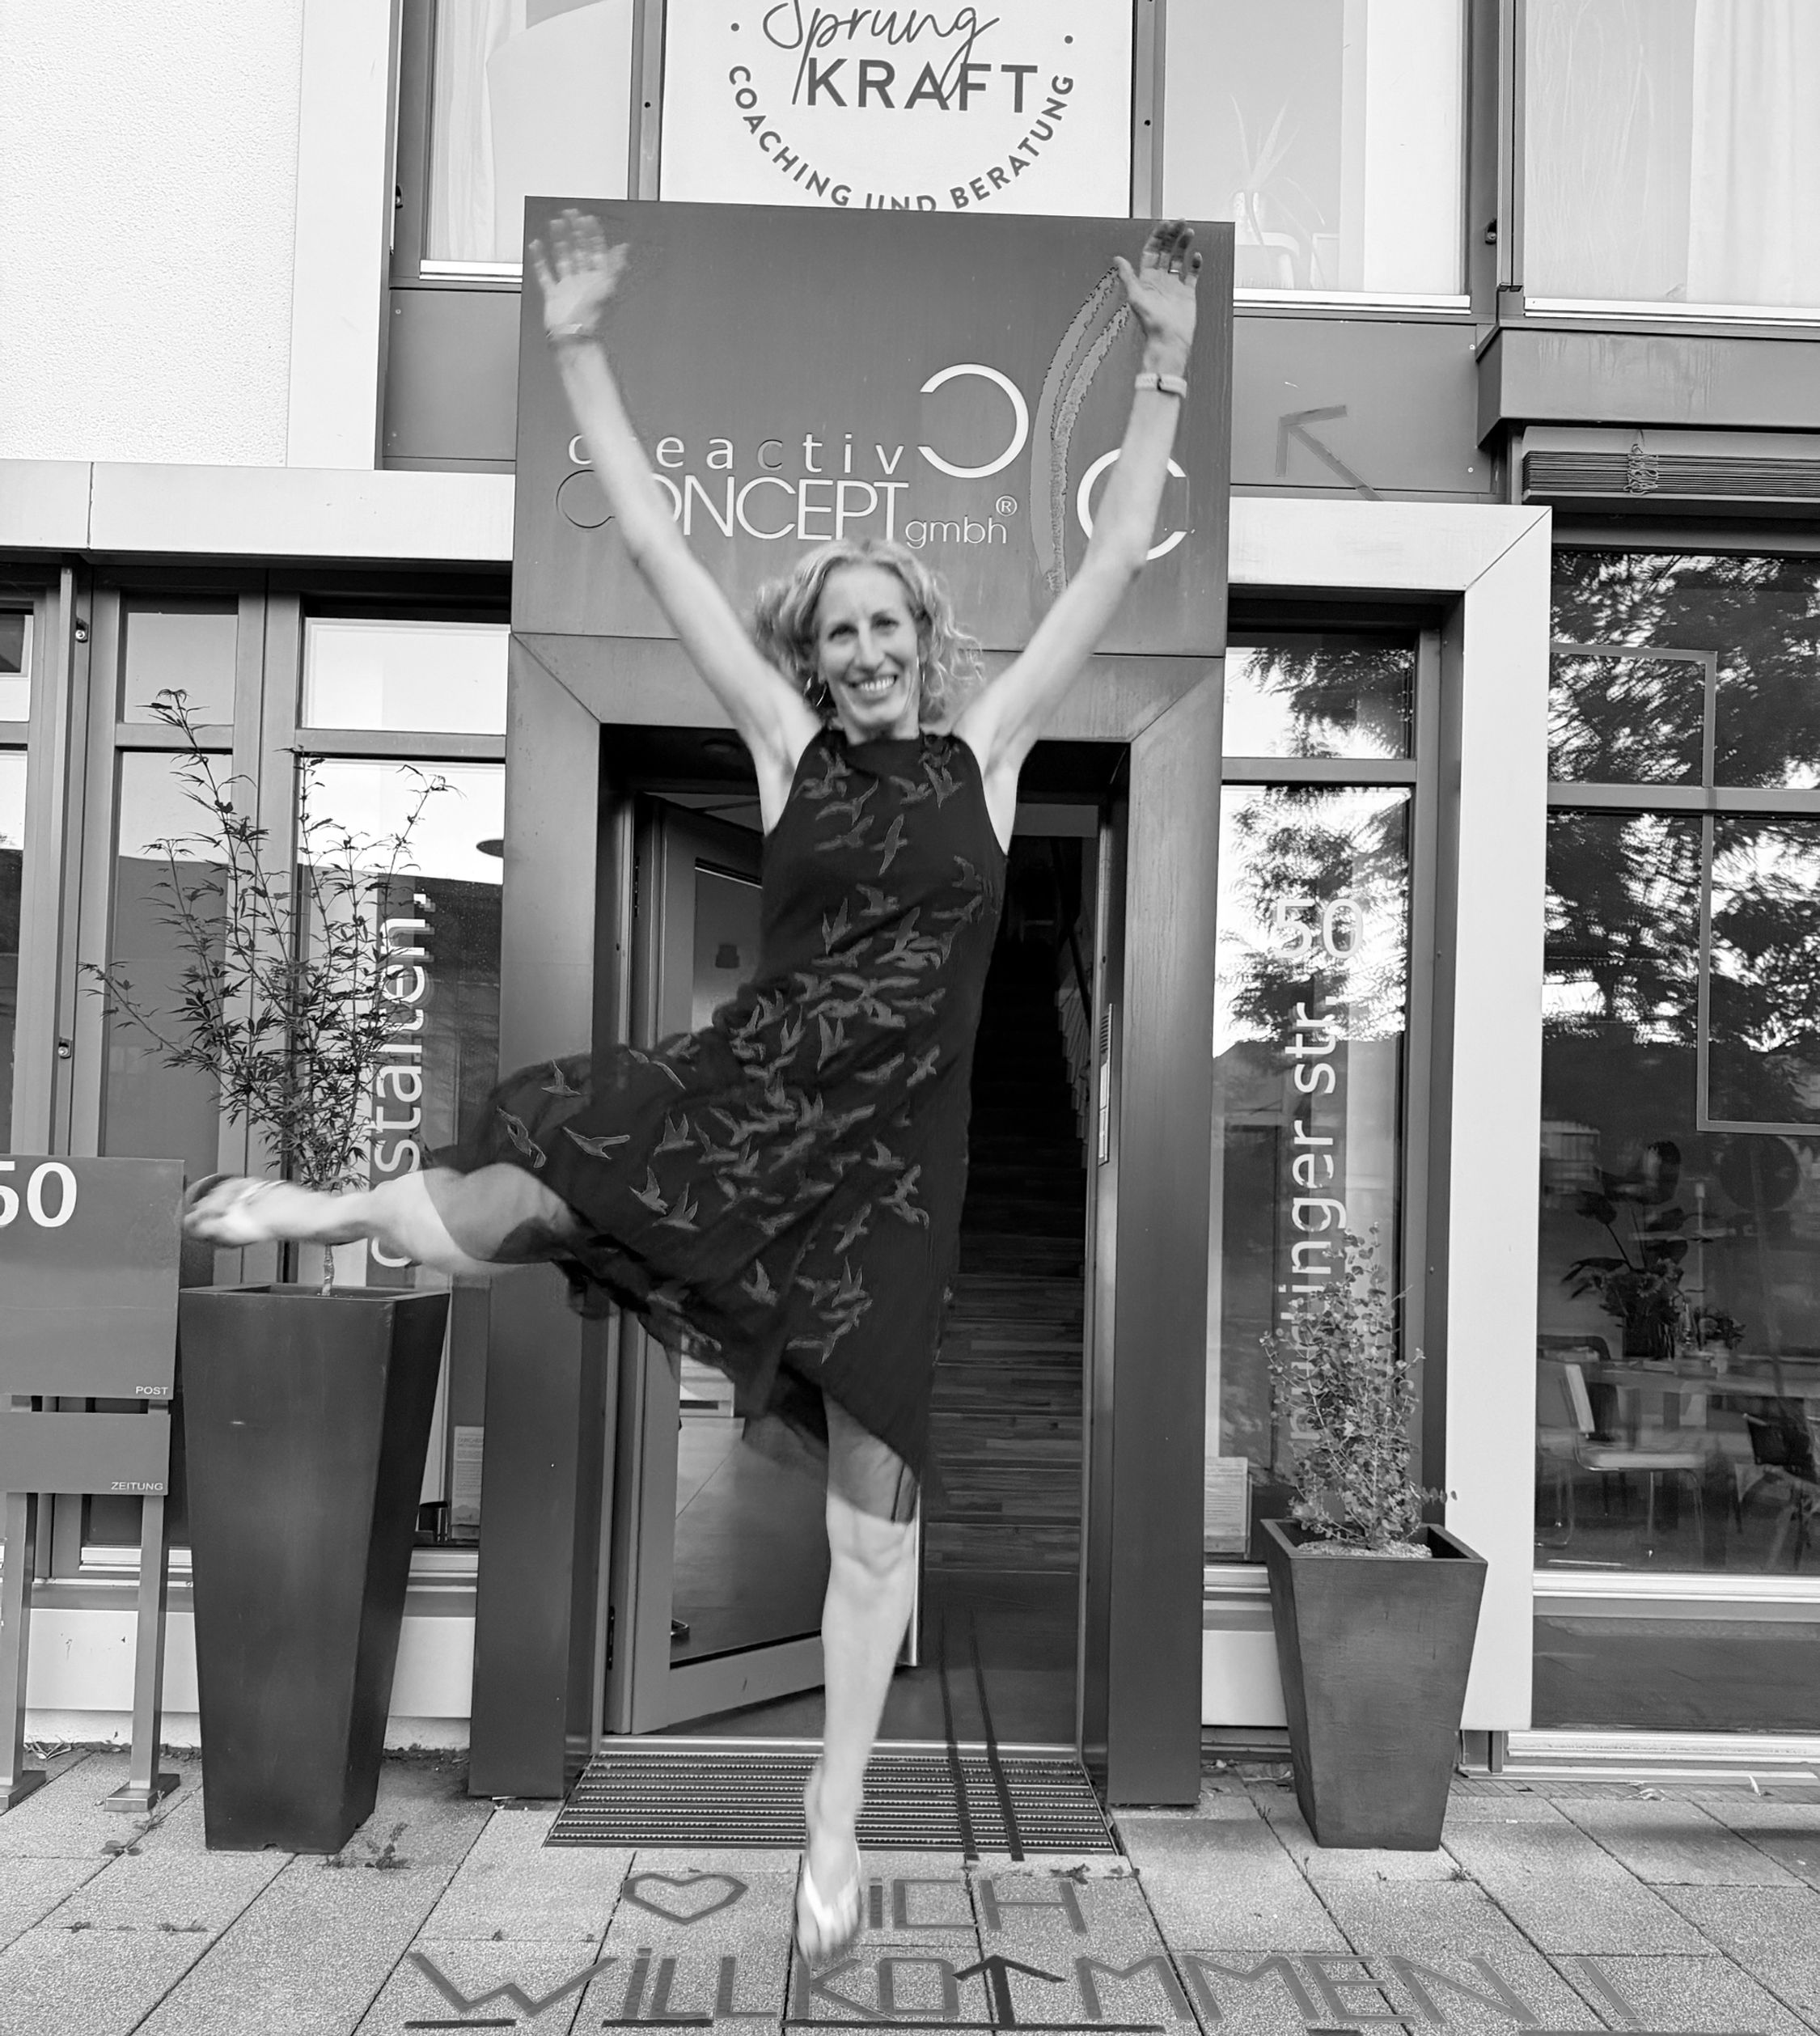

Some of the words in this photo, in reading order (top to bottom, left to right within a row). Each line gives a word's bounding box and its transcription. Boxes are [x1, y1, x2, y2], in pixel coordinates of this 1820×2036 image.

[807, 57, 1039, 113] KRAFT
[729, 66, 853, 207] COACHING
[950, 74, 1074, 210] BERATUNG
[568, 433, 905, 476] ceactiv
[1272, 898, 1364, 959] 50
[1285, 996, 1337, 1094] str.
[135, 1386, 169, 1396] POST
[110, 1480, 164, 1492] ZEITUNG
